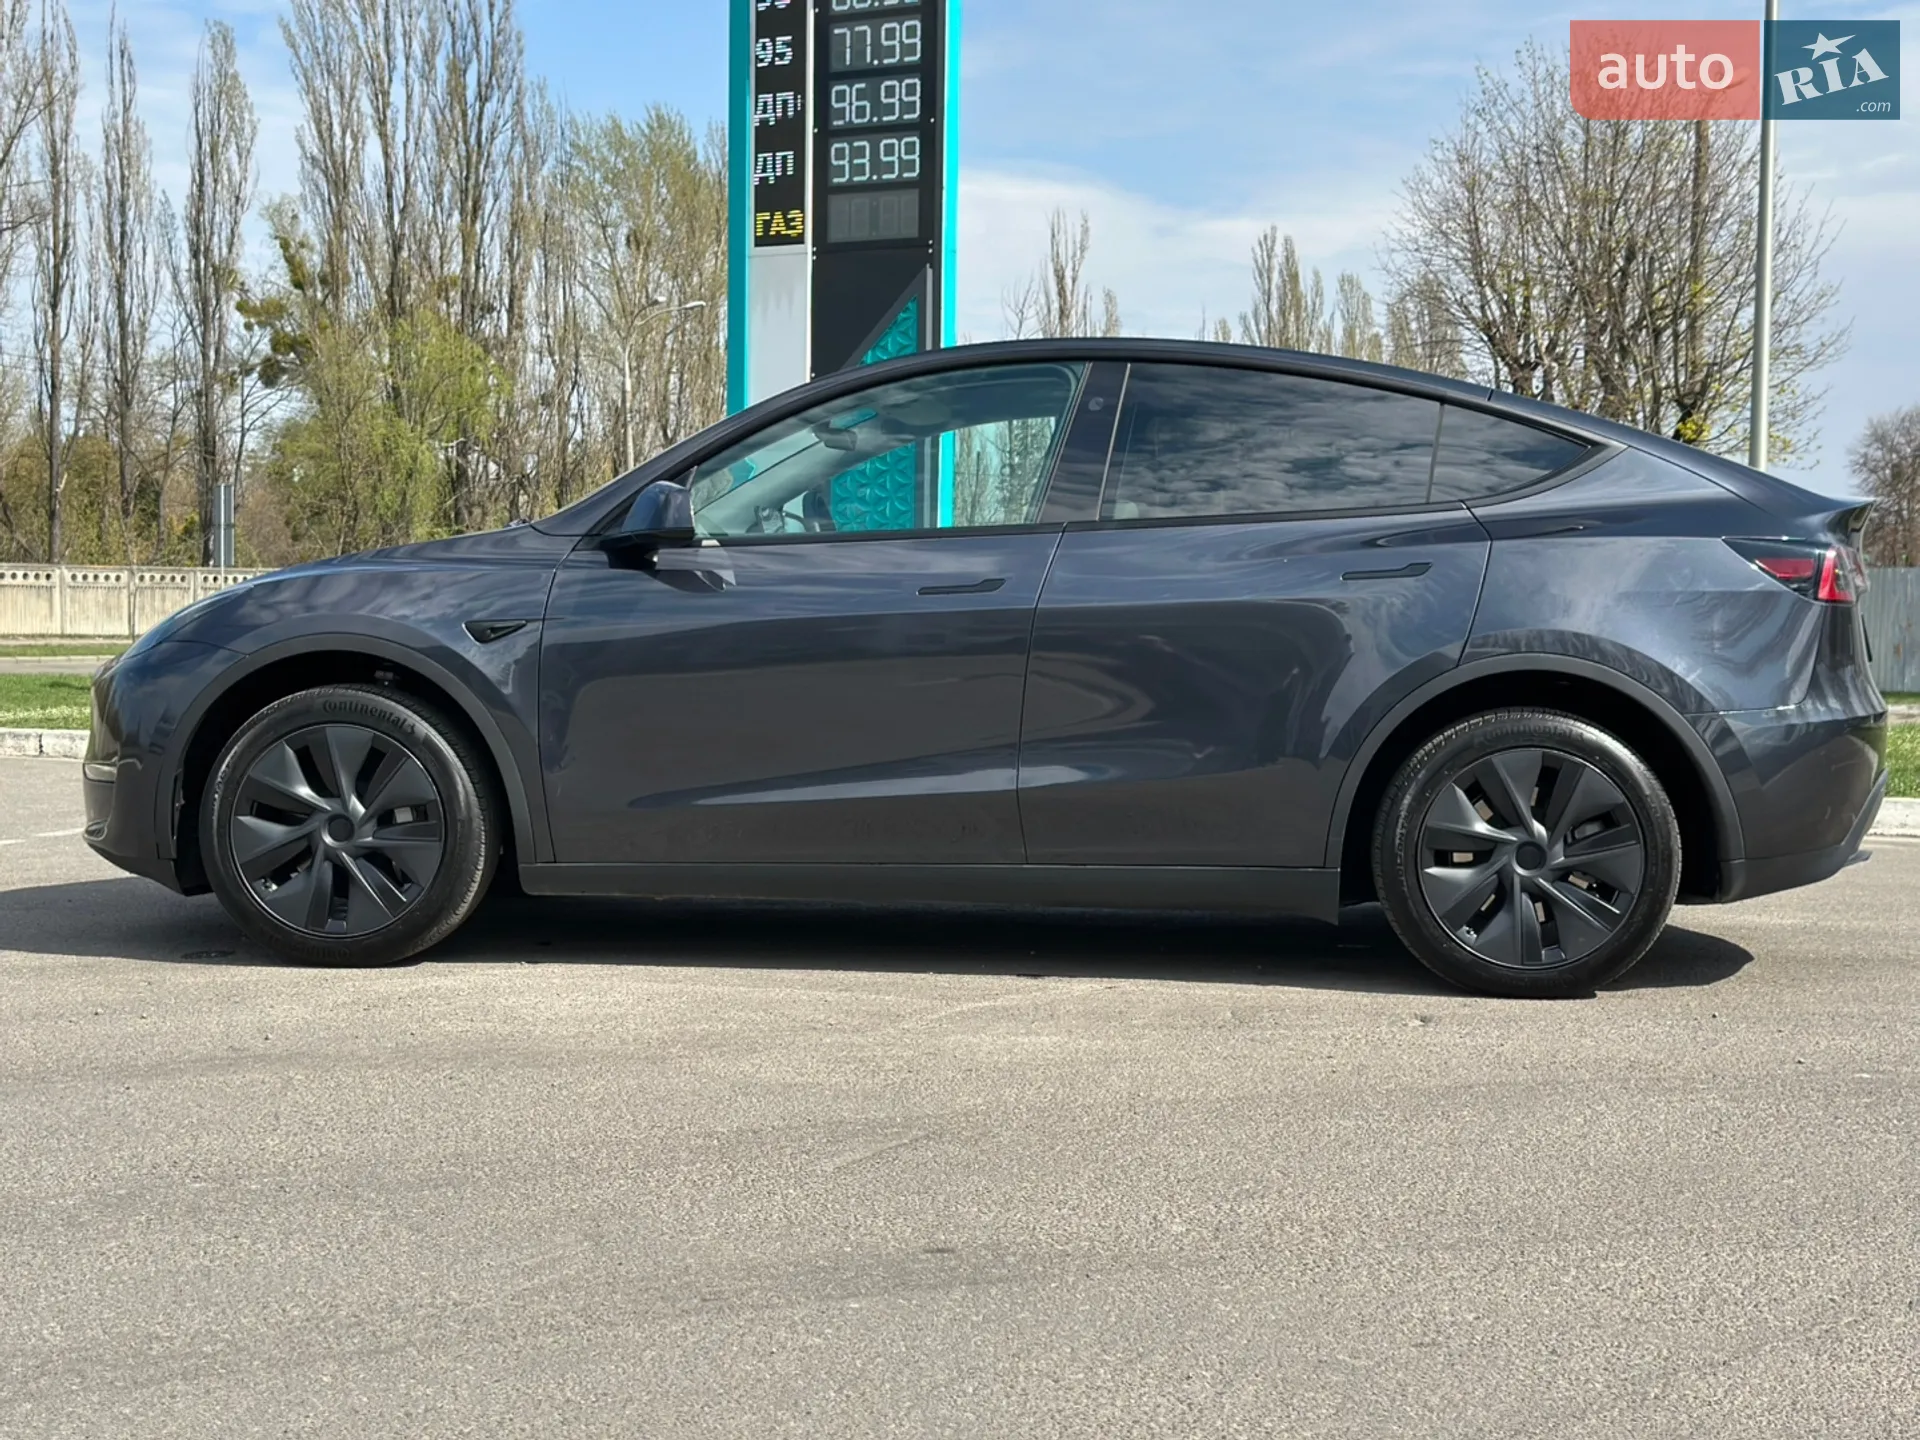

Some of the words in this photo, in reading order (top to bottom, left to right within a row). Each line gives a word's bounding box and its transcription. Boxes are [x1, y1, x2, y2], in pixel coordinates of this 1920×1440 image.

[754, 36, 793, 68] 95
[832, 19, 922, 66] 77.99
[831, 78, 921, 126] 96.99
[753, 150, 794, 186] ДП
[830, 136, 920, 184] 93.99
[755, 209, 804, 237] ГАЗ
[322, 699, 408, 730] Continental
